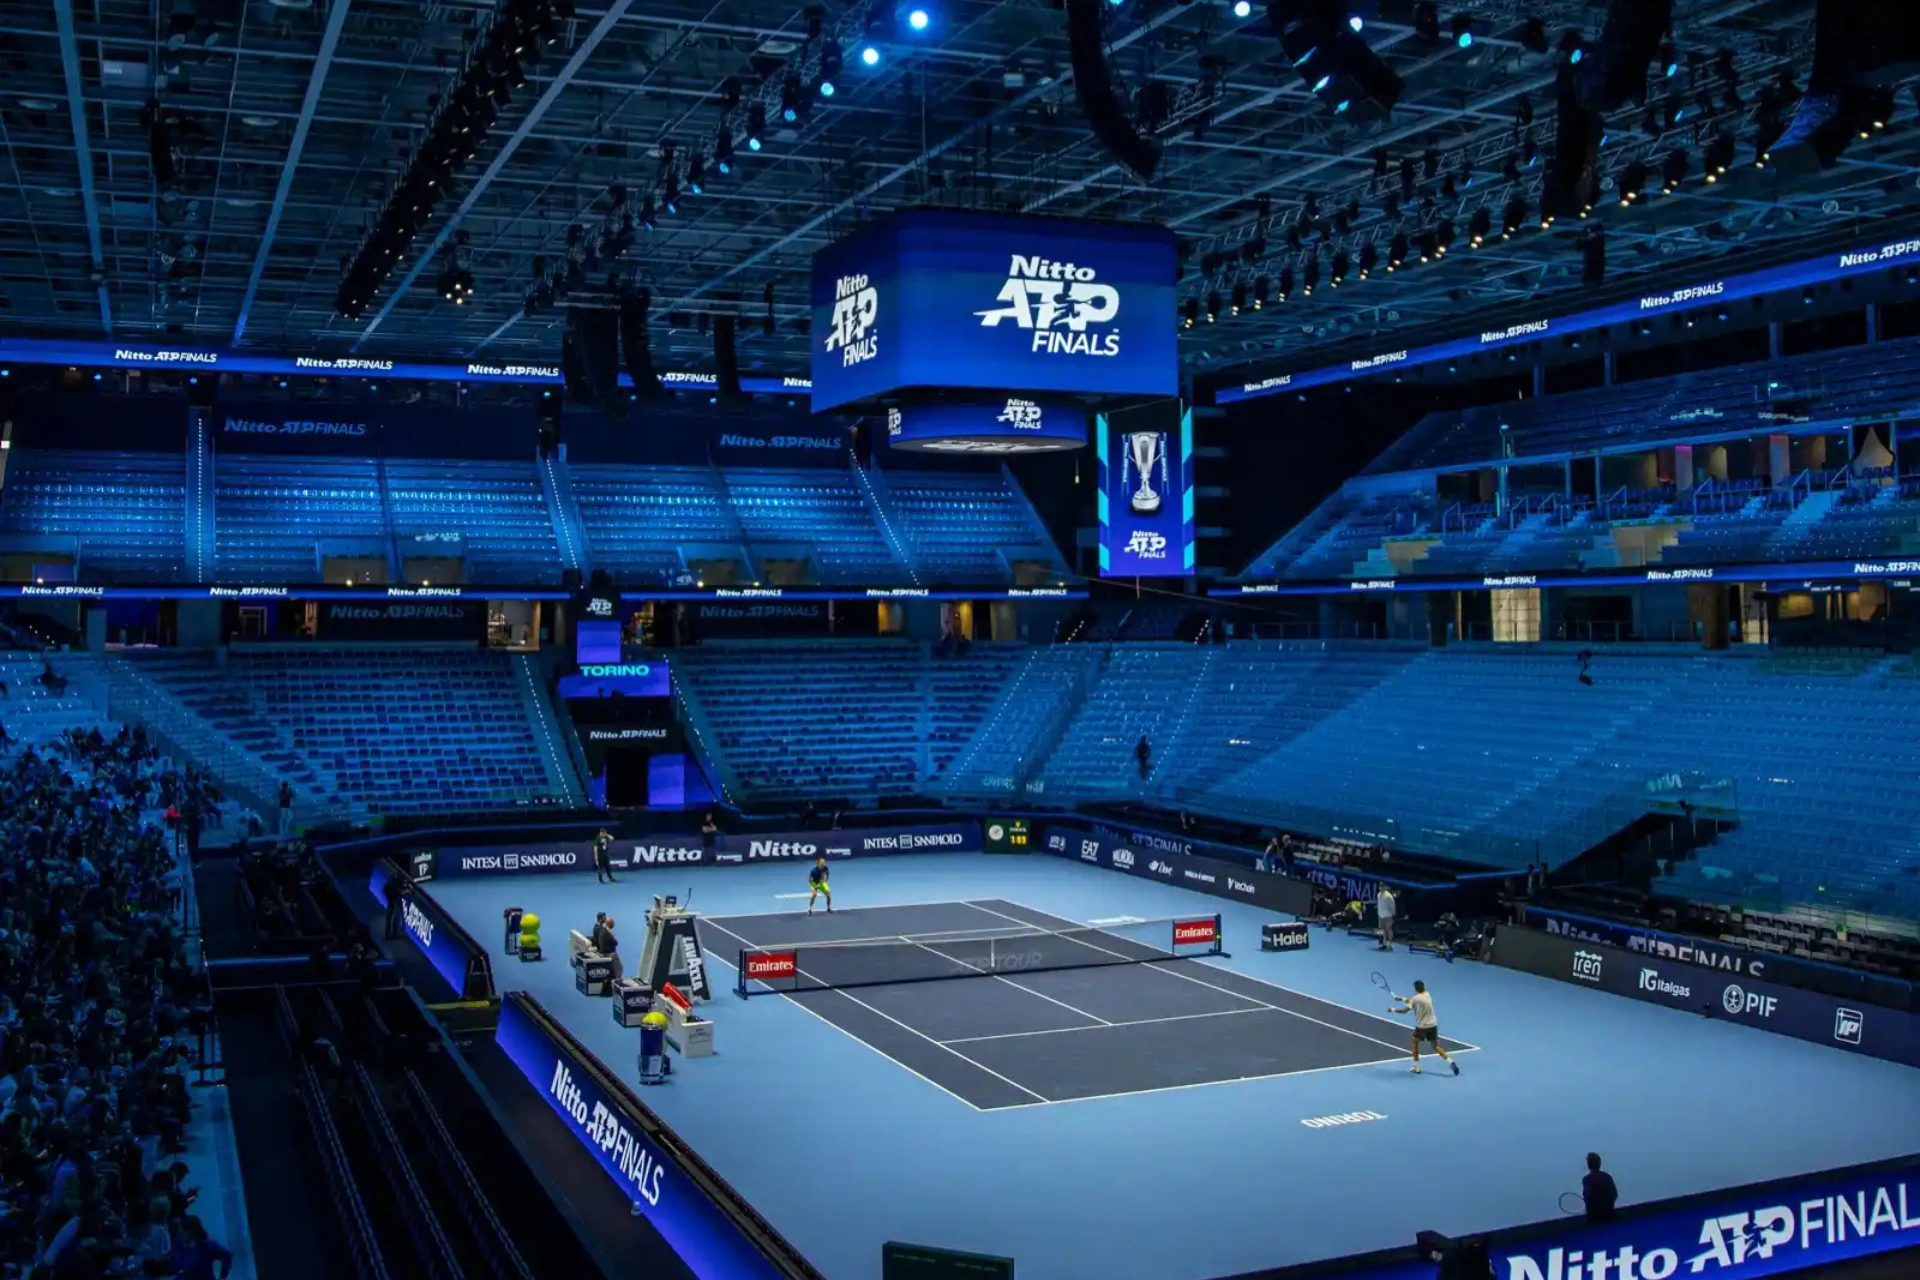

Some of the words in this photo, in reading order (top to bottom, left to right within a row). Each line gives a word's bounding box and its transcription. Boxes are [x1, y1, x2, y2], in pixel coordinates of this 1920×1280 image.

[1010, 254, 1096, 281] Nitto
[1840, 252, 1877, 268] Nitto
[836, 274, 869, 300] Nitto
[973, 278, 1120, 331] ATP
[1641, 297, 1670, 310] Nitto
[824, 287, 878, 352] ATP
[1032, 331, 1120, 356] FINALS
[1482, 332, 1505, 343] Nitto
[115, 349, 152, 361] Nitto
[843, 335, 878, 367] FINALS
[296, 357, 331, 368] Nitto
[467, 364, 502, 375] Nitto
[996, 405, 1042, 422] ATP
[223, 415, 276, 433] Nitto
[720, 434, 766, 447] Nitto
[1123, 537, 1166, 552] ATP
[1647, 571, 1671, 580] Nitto
[1854, 563, 1885, 574] Nitto
[22, 586, 52, 595] Nitto
[210, 587, 238, 596] Nitto
[331, 604, 380, 619] Nitto
[580, 664, 650, 677] TORINO
[749, 840, 817, 858] Nitto
[864, 837, 899, 850] INTESA
[913, 833, 963, 847] SANPAOLO
[1081, 840, 1099, 857] EA7
[462, 856, 501, 869] INTESA
[520, 852, 577, 867] SANPAOLO
[632, 845, 703, 863] Nitto
[1175, 927, 1214, 939] Emirates
[1272, 931, 1308, 946] Haier
[682, 936, 704, 992] LAVAZZA
[749, 960, 794, 972] Emirates
[1572, 956, 1601, 976] iren
[1656, 979, 1690, 997] Italgas
[1745, 992, 1778, 1018] PIF
[1300, 1109, 1389, 1129] TORINO
[550, 1059, 588, 1125] Nitto
[612, 1125, 665, 1206] FINALS
[1506, 1245, 1679, 1280] Nitto
[1800, 1183, 1920, 1250] FINAL
